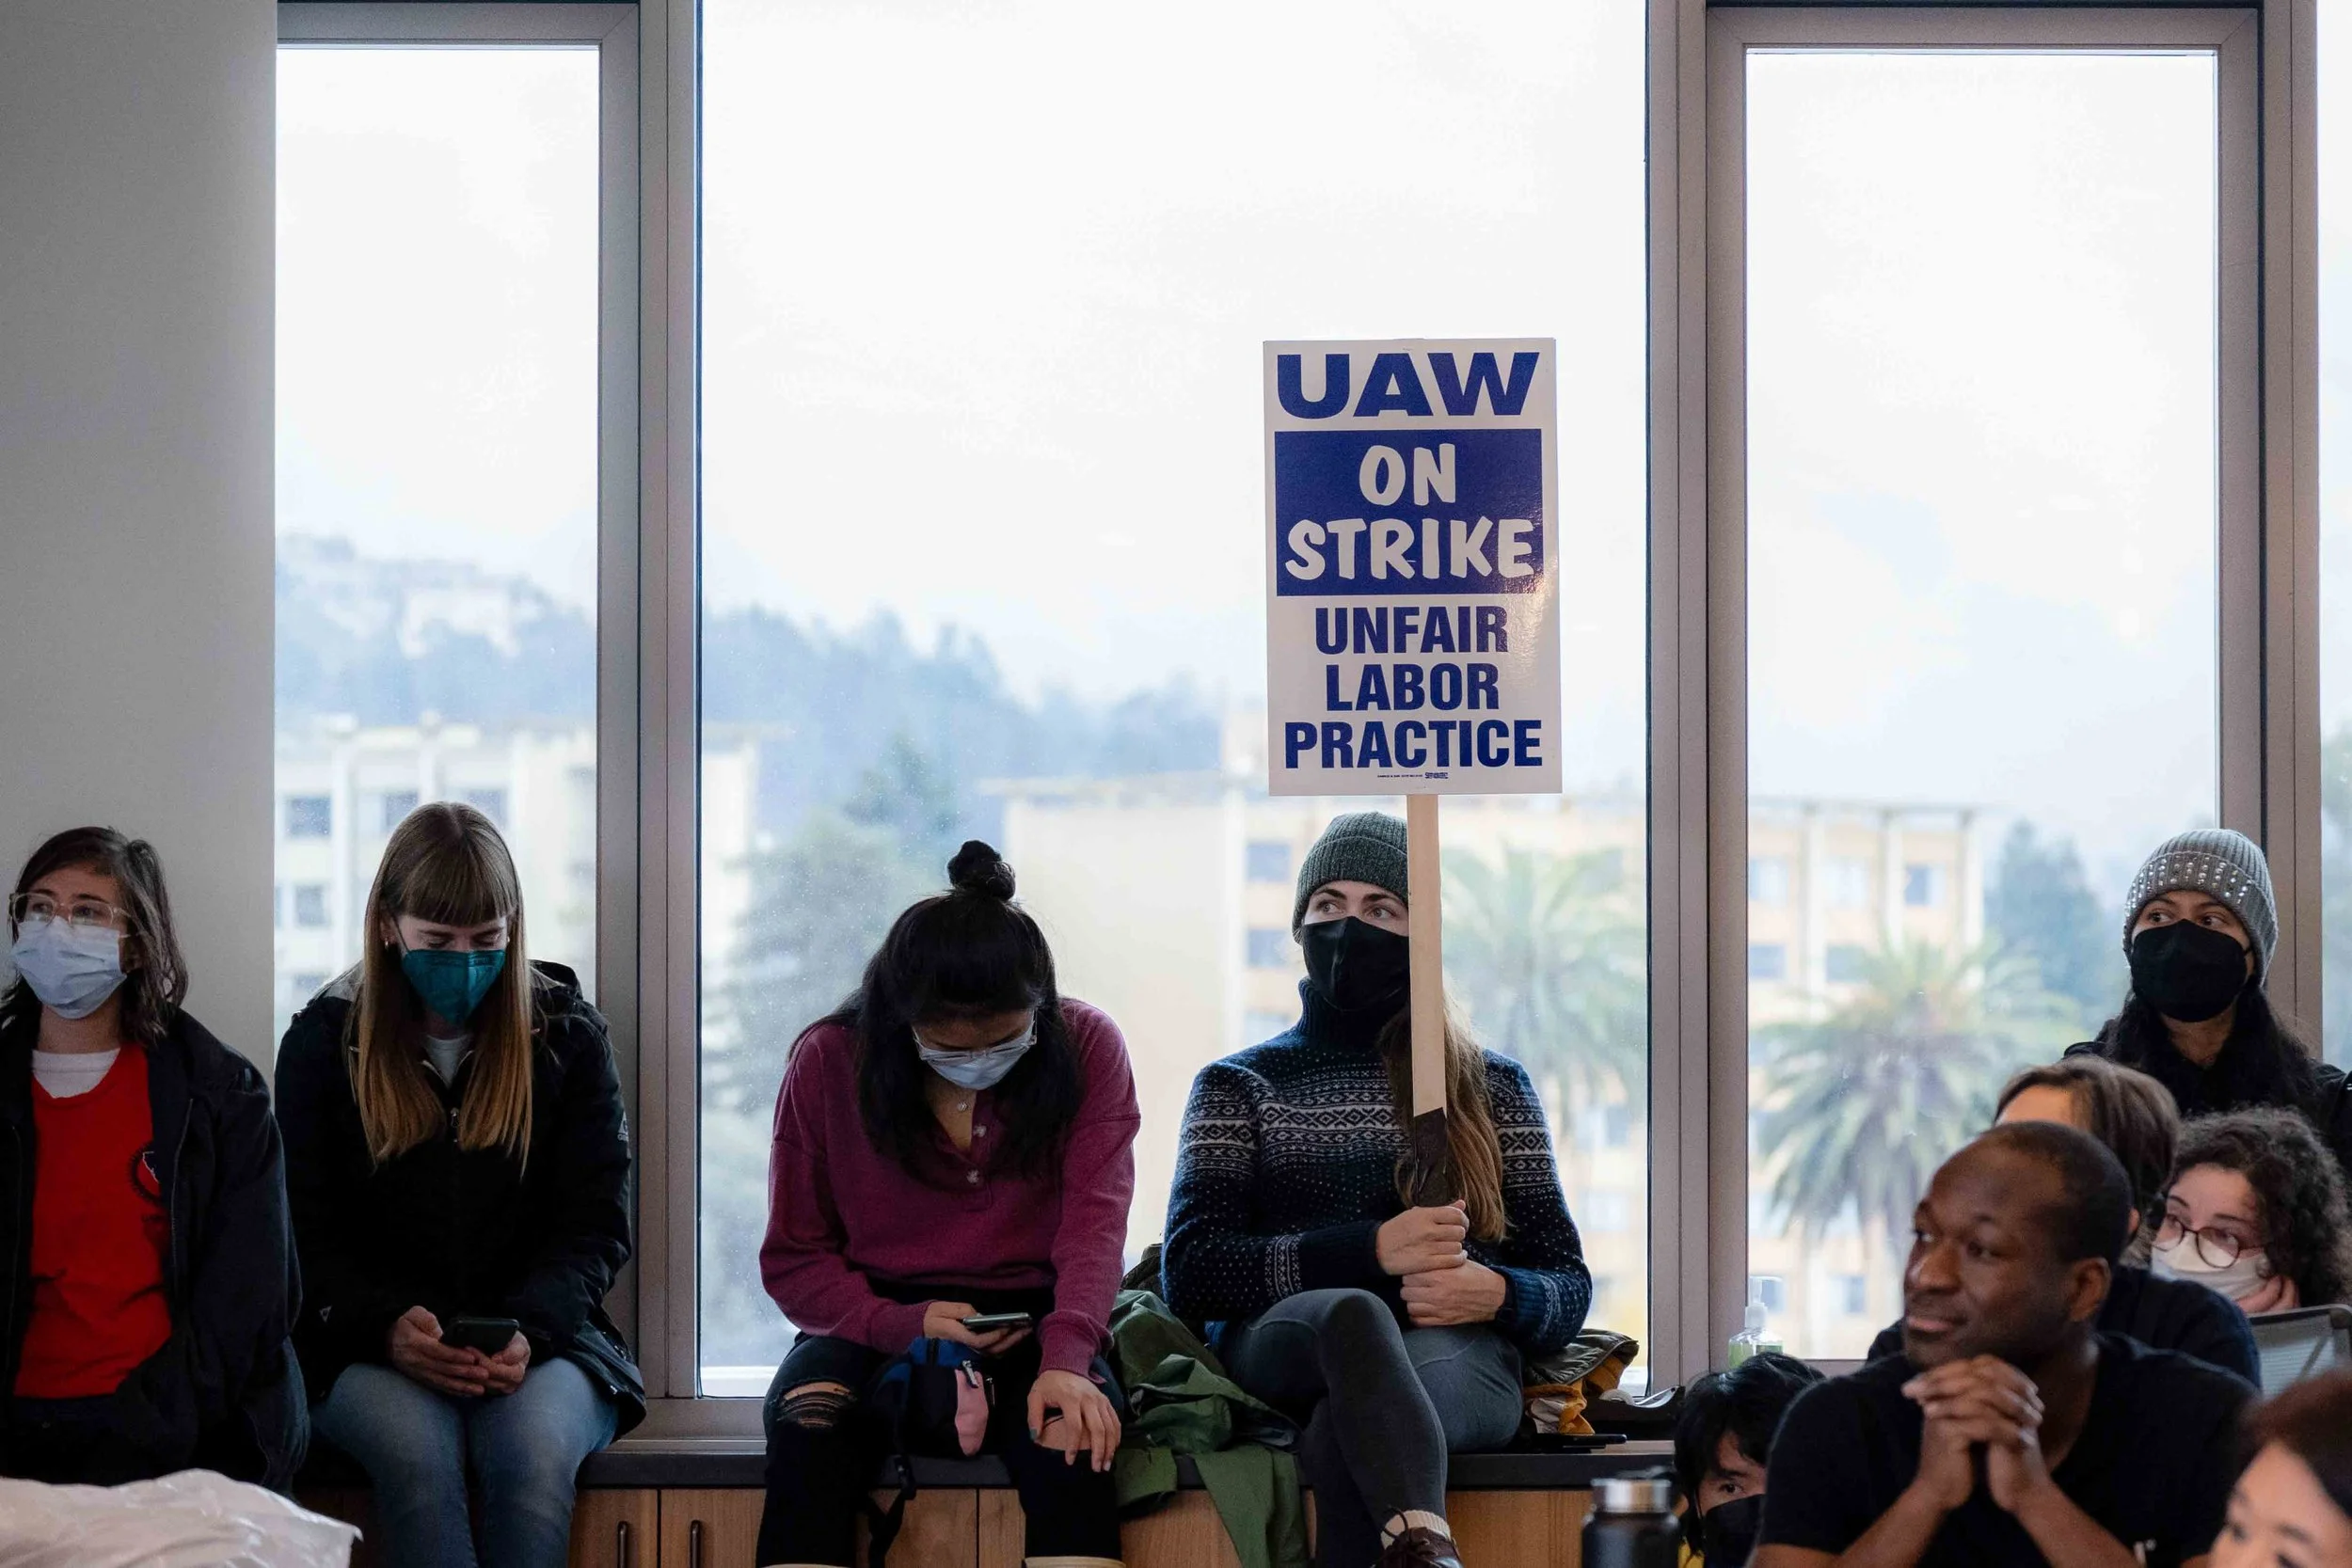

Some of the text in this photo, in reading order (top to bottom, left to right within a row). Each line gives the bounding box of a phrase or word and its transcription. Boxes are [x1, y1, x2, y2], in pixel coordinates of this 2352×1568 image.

[1277, 352, 1540, 420] UAW
[1359, 443, 1455, 506] ON
[1285, 515, 1534, 580] STRIKE
[1315, 606, 1508, 655] UNFAIR
[1326, 662, 1500, 712] LABOR
[1284, 720, 1543, 769] PRACTICE
